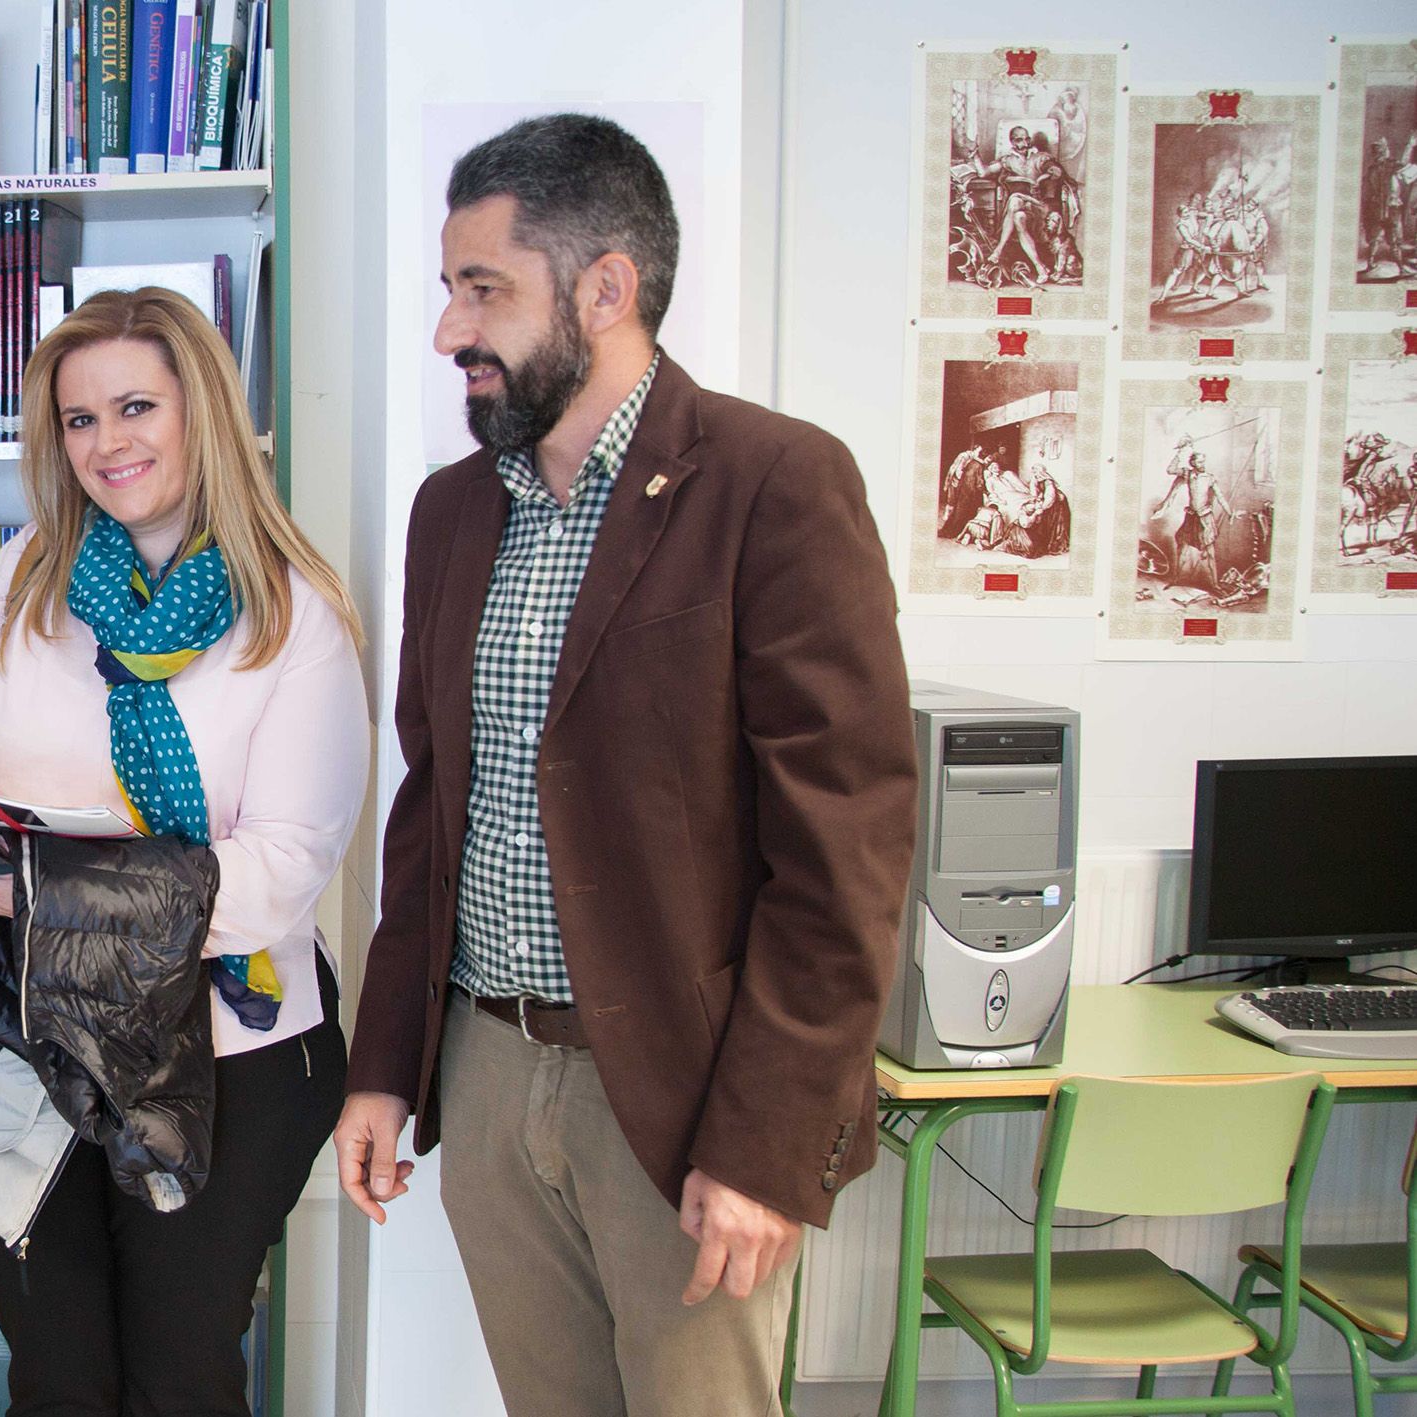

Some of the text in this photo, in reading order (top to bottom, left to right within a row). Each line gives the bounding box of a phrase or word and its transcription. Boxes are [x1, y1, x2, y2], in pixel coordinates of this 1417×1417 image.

[102, 6, 117, 84] CELULA
[148, 12, 164, 82] GENÉTICA
[204, 56, 224, 142] BIOQUÍMICA
[16, 178, 98, 189] NATURALES
[4, 212, 14, 224] 2
[15, 208, 21, 221] 1
[30, 208, 40, 221] 2
